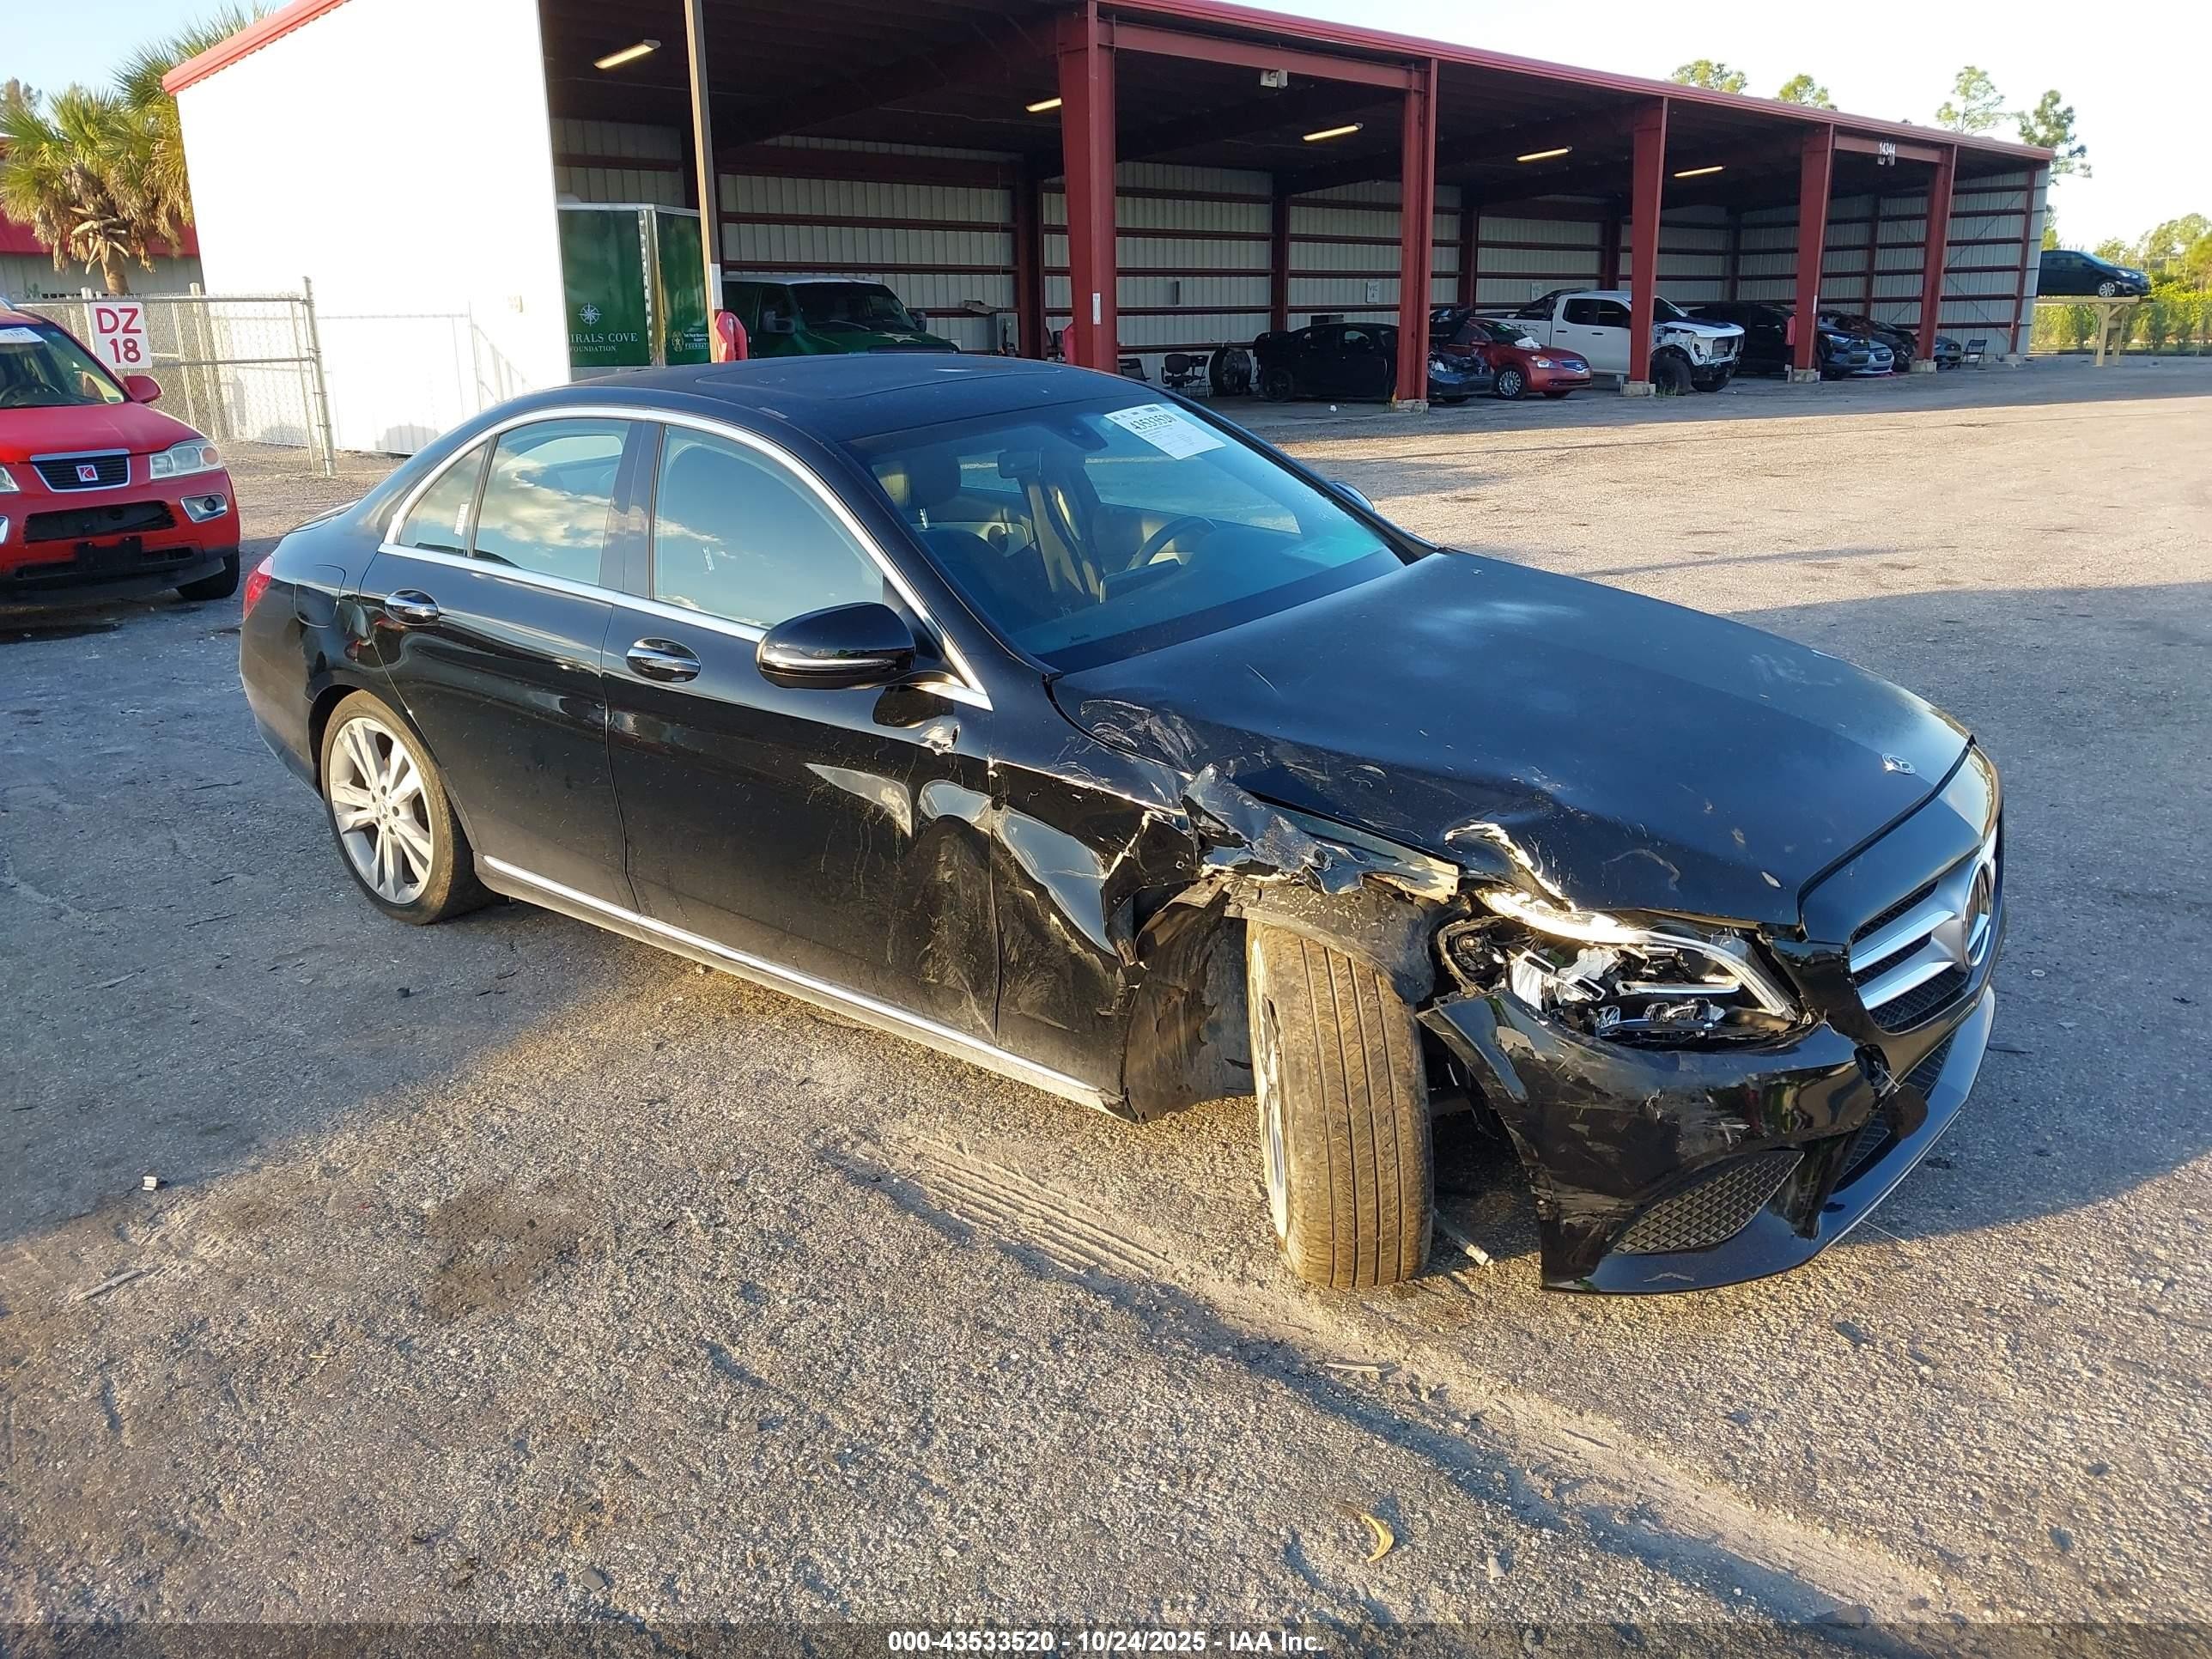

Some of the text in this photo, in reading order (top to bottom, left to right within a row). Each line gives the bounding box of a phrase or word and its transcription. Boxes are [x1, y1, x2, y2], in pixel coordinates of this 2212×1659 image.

[95, 307, 142, 334] DZ
[109, 337, 141, 364] 18
[608, 332, 638, 343] COVE
